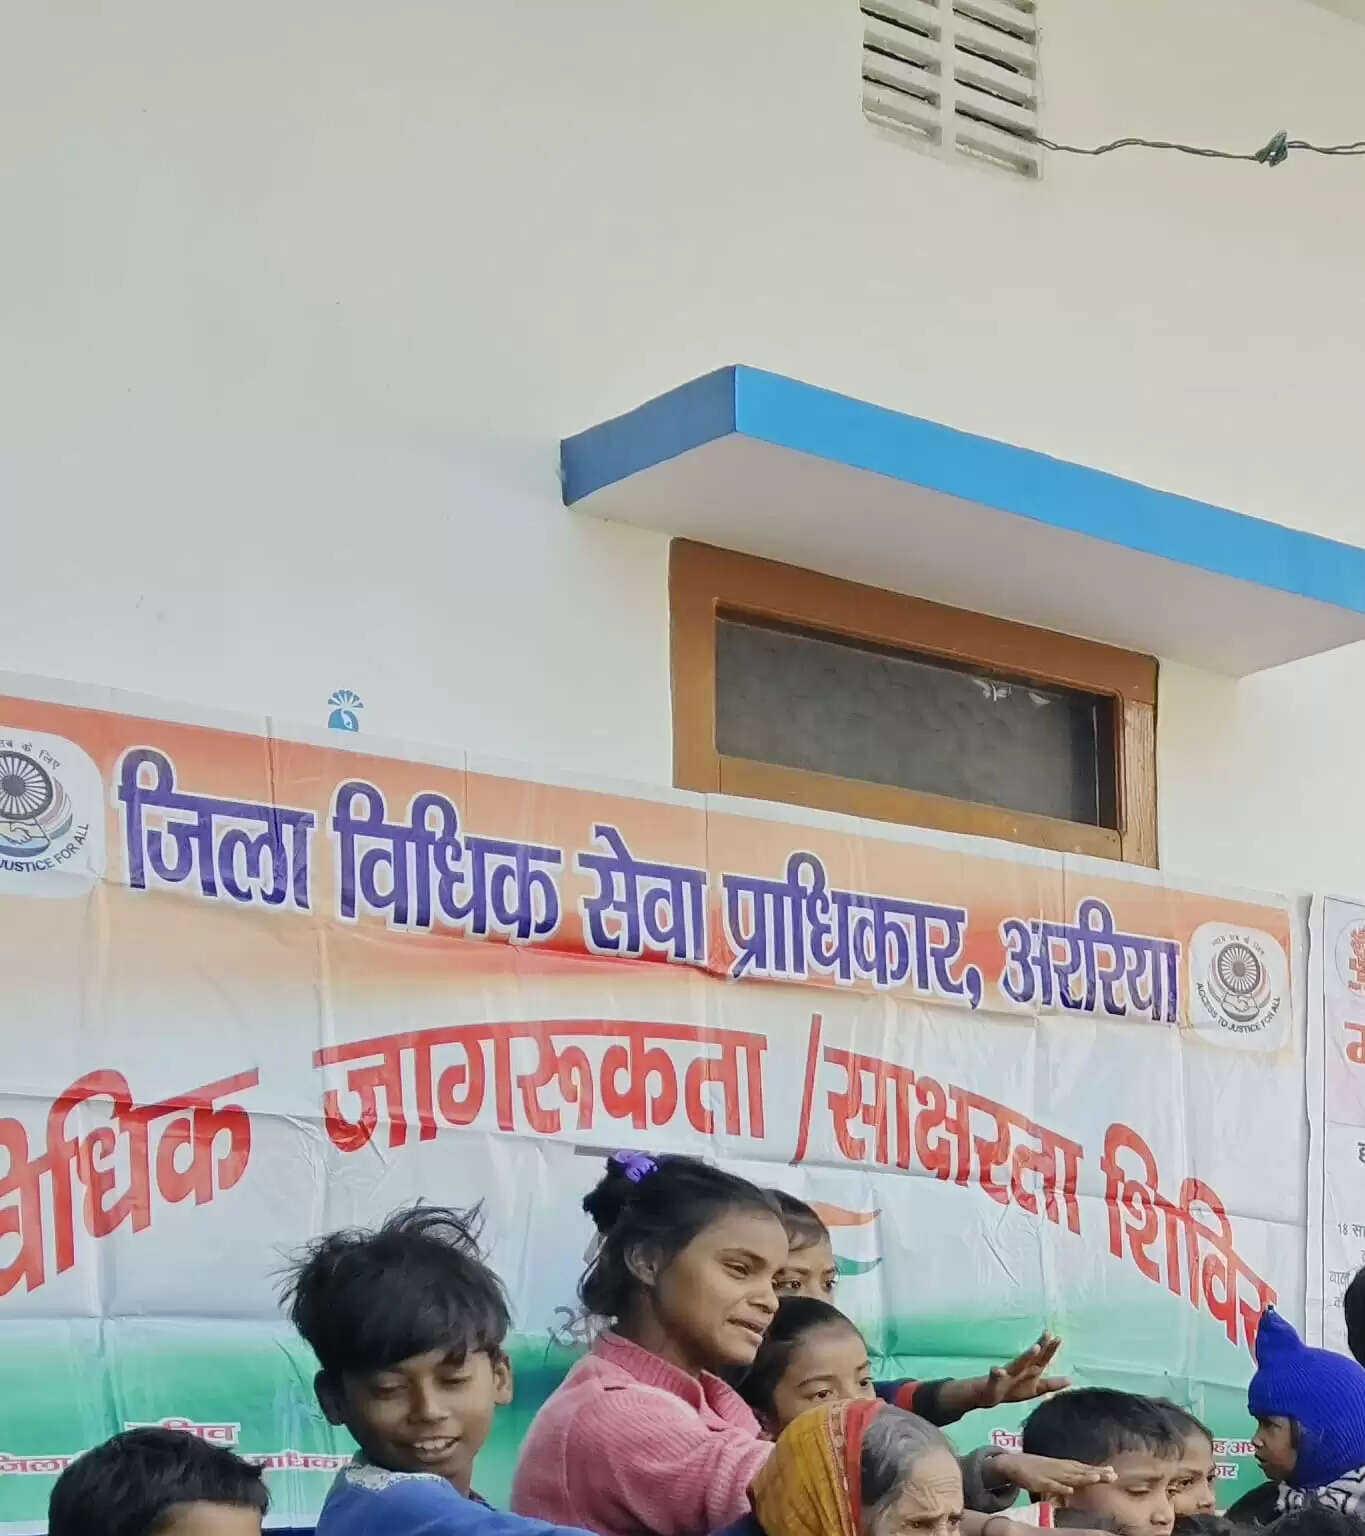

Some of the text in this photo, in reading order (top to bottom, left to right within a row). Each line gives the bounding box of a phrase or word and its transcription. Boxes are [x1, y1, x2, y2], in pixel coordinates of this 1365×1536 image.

[54, 843, 79, 864] FOR
[74, 823, 89, 846] ALL
[118, 748, 1180, 1022] जिला विधिक सेवा प्राधिकार, अररिया
[1228, 1023, 1261, 1033] JUSTICE
[313, 1018, 767, 1154] जागरूकता
